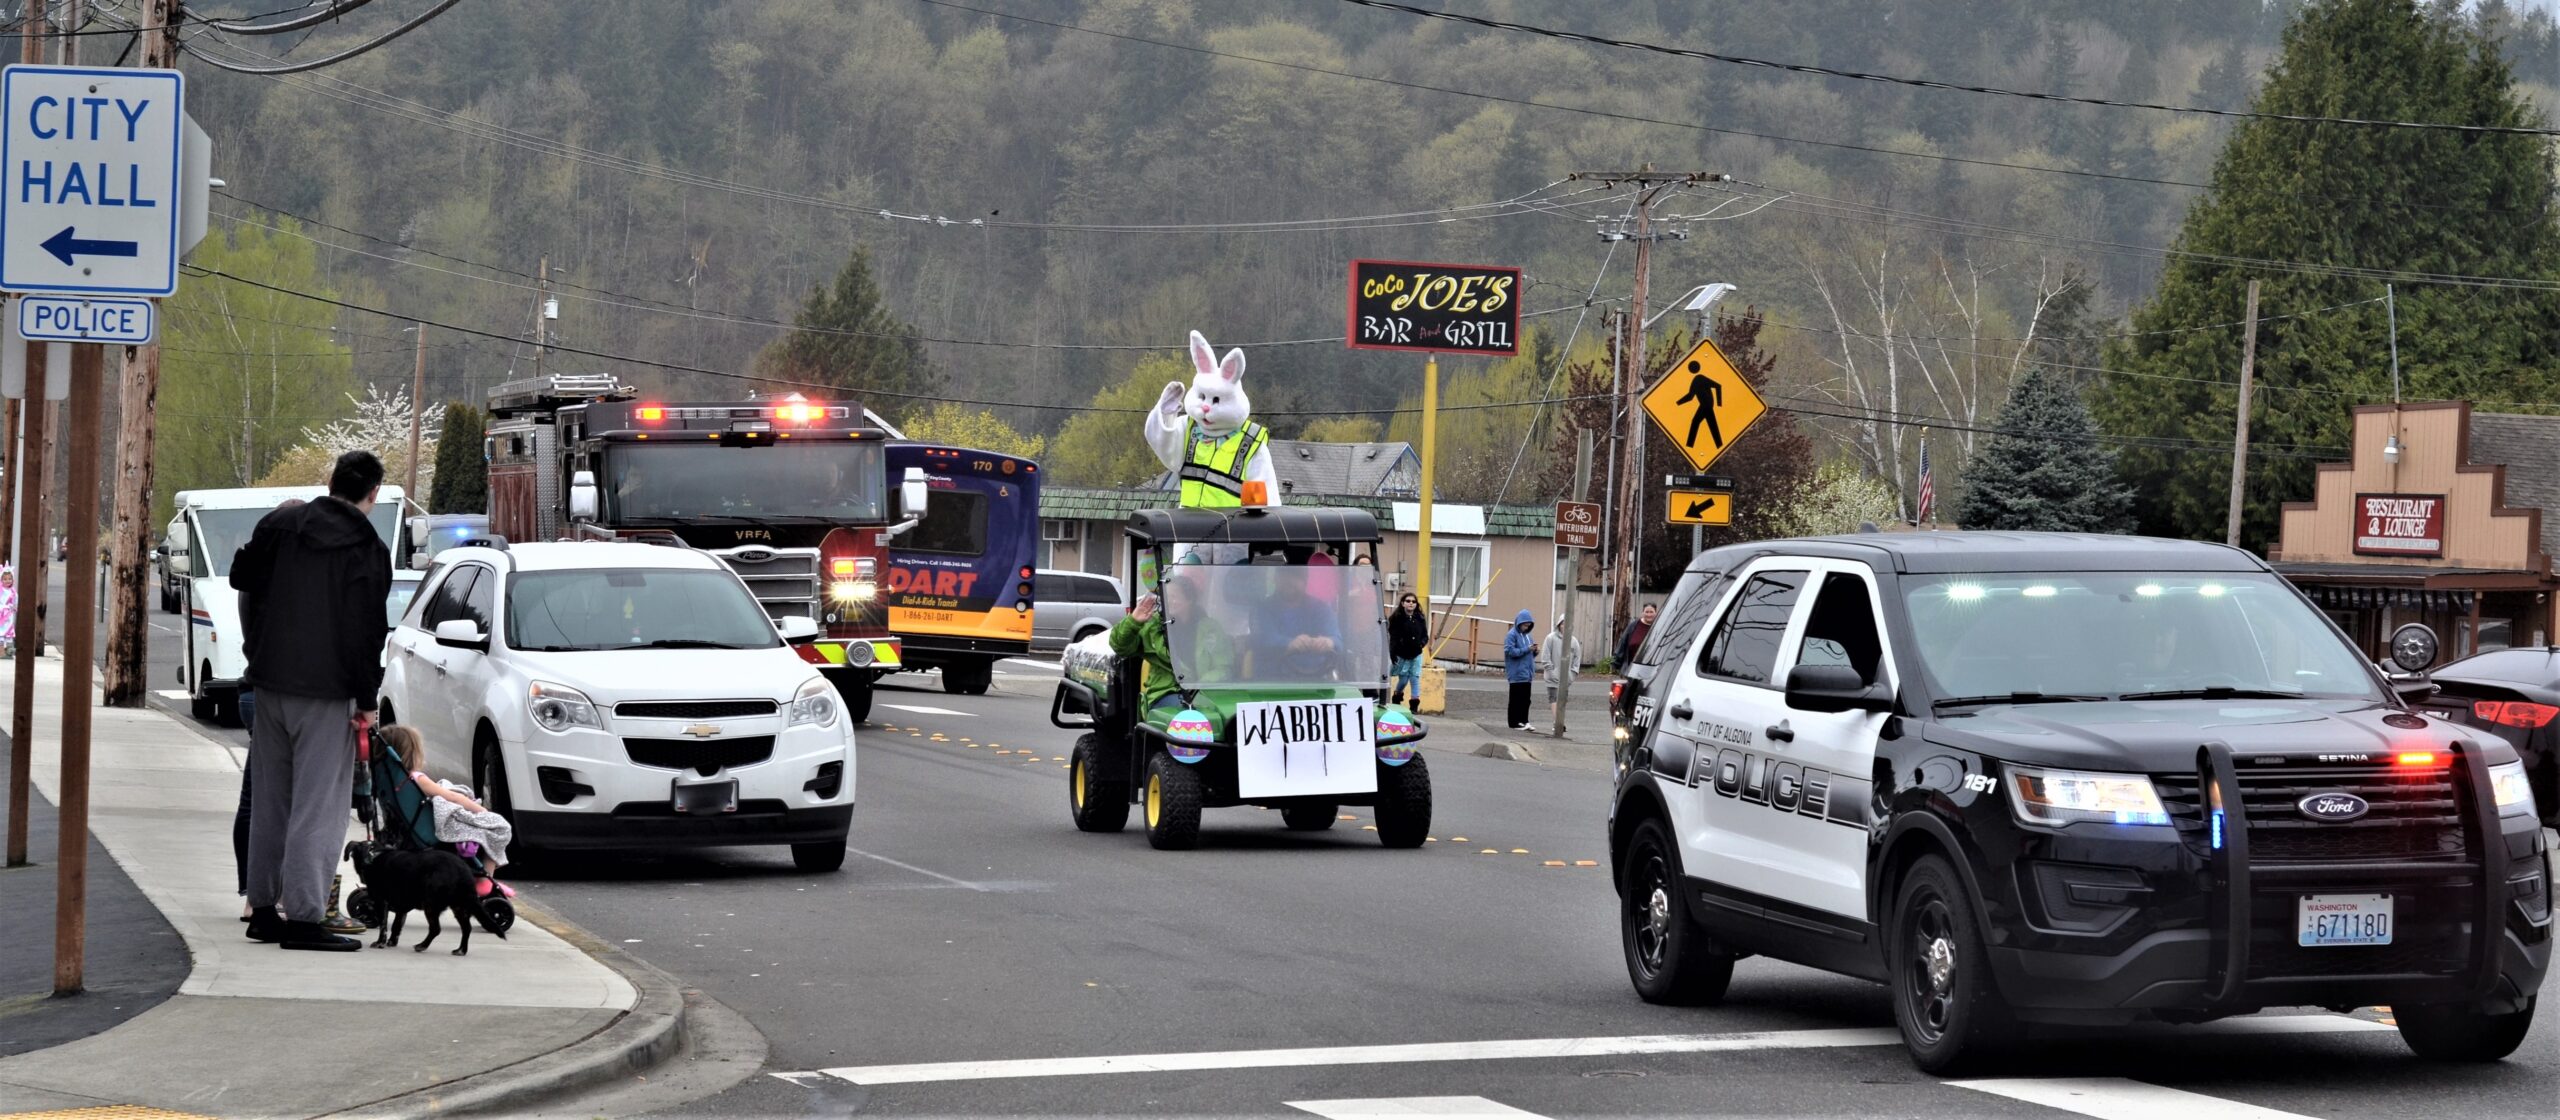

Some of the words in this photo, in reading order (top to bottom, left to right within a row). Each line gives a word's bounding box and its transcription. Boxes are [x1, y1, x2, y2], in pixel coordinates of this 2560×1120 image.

[29, 95, 150, 142] CITY
[21, 160, 156, 207] HALL
[1363, 273, 1405, 299] CoCo
[1390, 273, 1514, 314] JOE'S
[35, 305, 135, 334] POLICE
[1363, 315, 1413, 344] BAR
[1419, 323, 1441, 340] And
[1444, 320, 1512, 348] GRILL
[973, 460, 993, 471] 170
[2365, 498, 2435, 518] RESTAURANT
[735, 530, 772, 540] VRFA
[1556, 522, 1598, 535] INTERURBAN
[2383, 517, 2427, 537] LOUNGE
[1567, 534, 1585, 545] TRAIL
[887, 567, 977, 597] DART
[937, 597, 958, 607] Transit
[1242, 703, 1347, 746] WABBIT
[1355, 705, 1367, 742] 1
[1632, 704, 1654, 729] 911
[1697, 720, 1713, 736] CITY
[1713, 724, 1724, 739] OF
[1723, 726, 1753, 746] ALGONA
[2318, 754, 2369, 762] SETINA
[1688, 741, 1831, 821] POLICE
[1964, 773, 1998, 794] 181
[2316, 797, 2356, 813] Ford
[2307, 903, 2358, 912] WASHINGTON
[2317, 912, 2387, 938] 67118D
